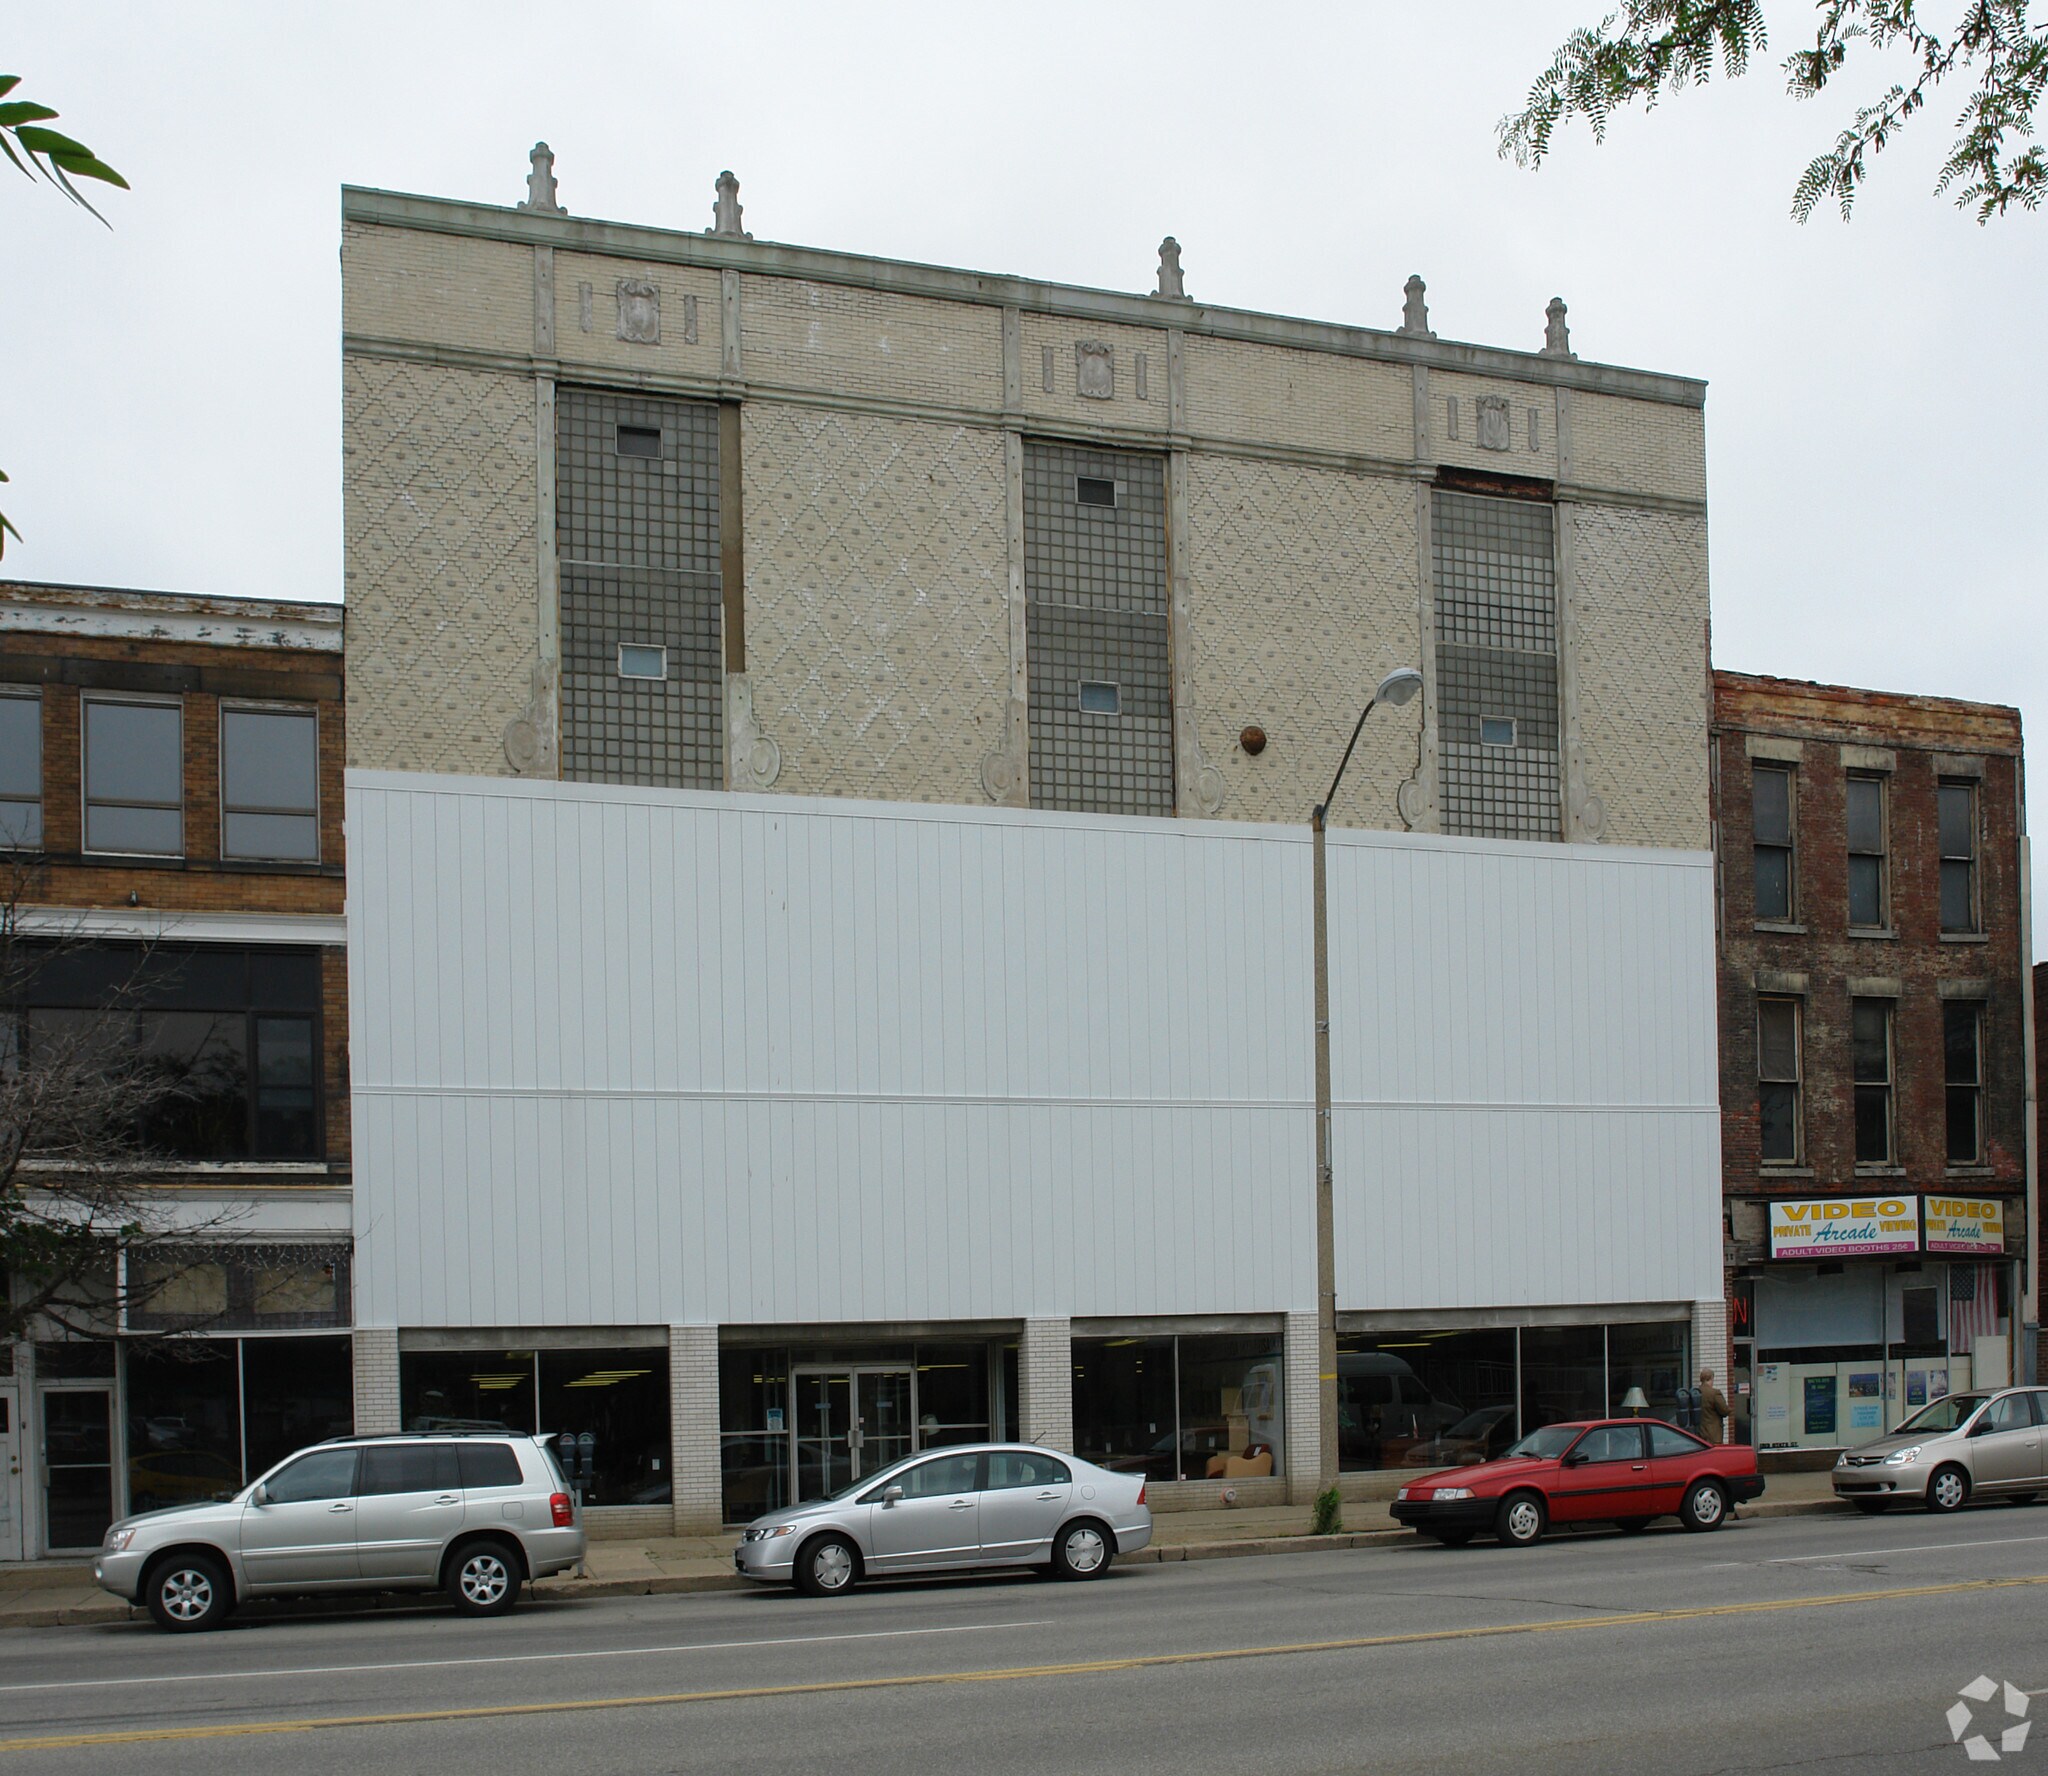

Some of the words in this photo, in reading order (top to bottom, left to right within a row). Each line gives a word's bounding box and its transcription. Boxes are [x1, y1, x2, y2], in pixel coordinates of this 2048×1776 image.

[1781, 1200, 1907, 1221] VIDEO
[1930, 1200, 1996, 1219] VIDEO
[1773, 1224, 1812, 1238] PRIVATE
[1879, 1219, 1917, 1233] VIEWING
[1813, 1221, 1877, 1243] Arcade
[1946, 1219, 1981, 1238] Arcade
[1781, 1247, 1815, 1256] ADULT
[1815, 1245, 1846, 1255] VIDEO
[1848, 1243, 1890, 1252] BOOTHS
